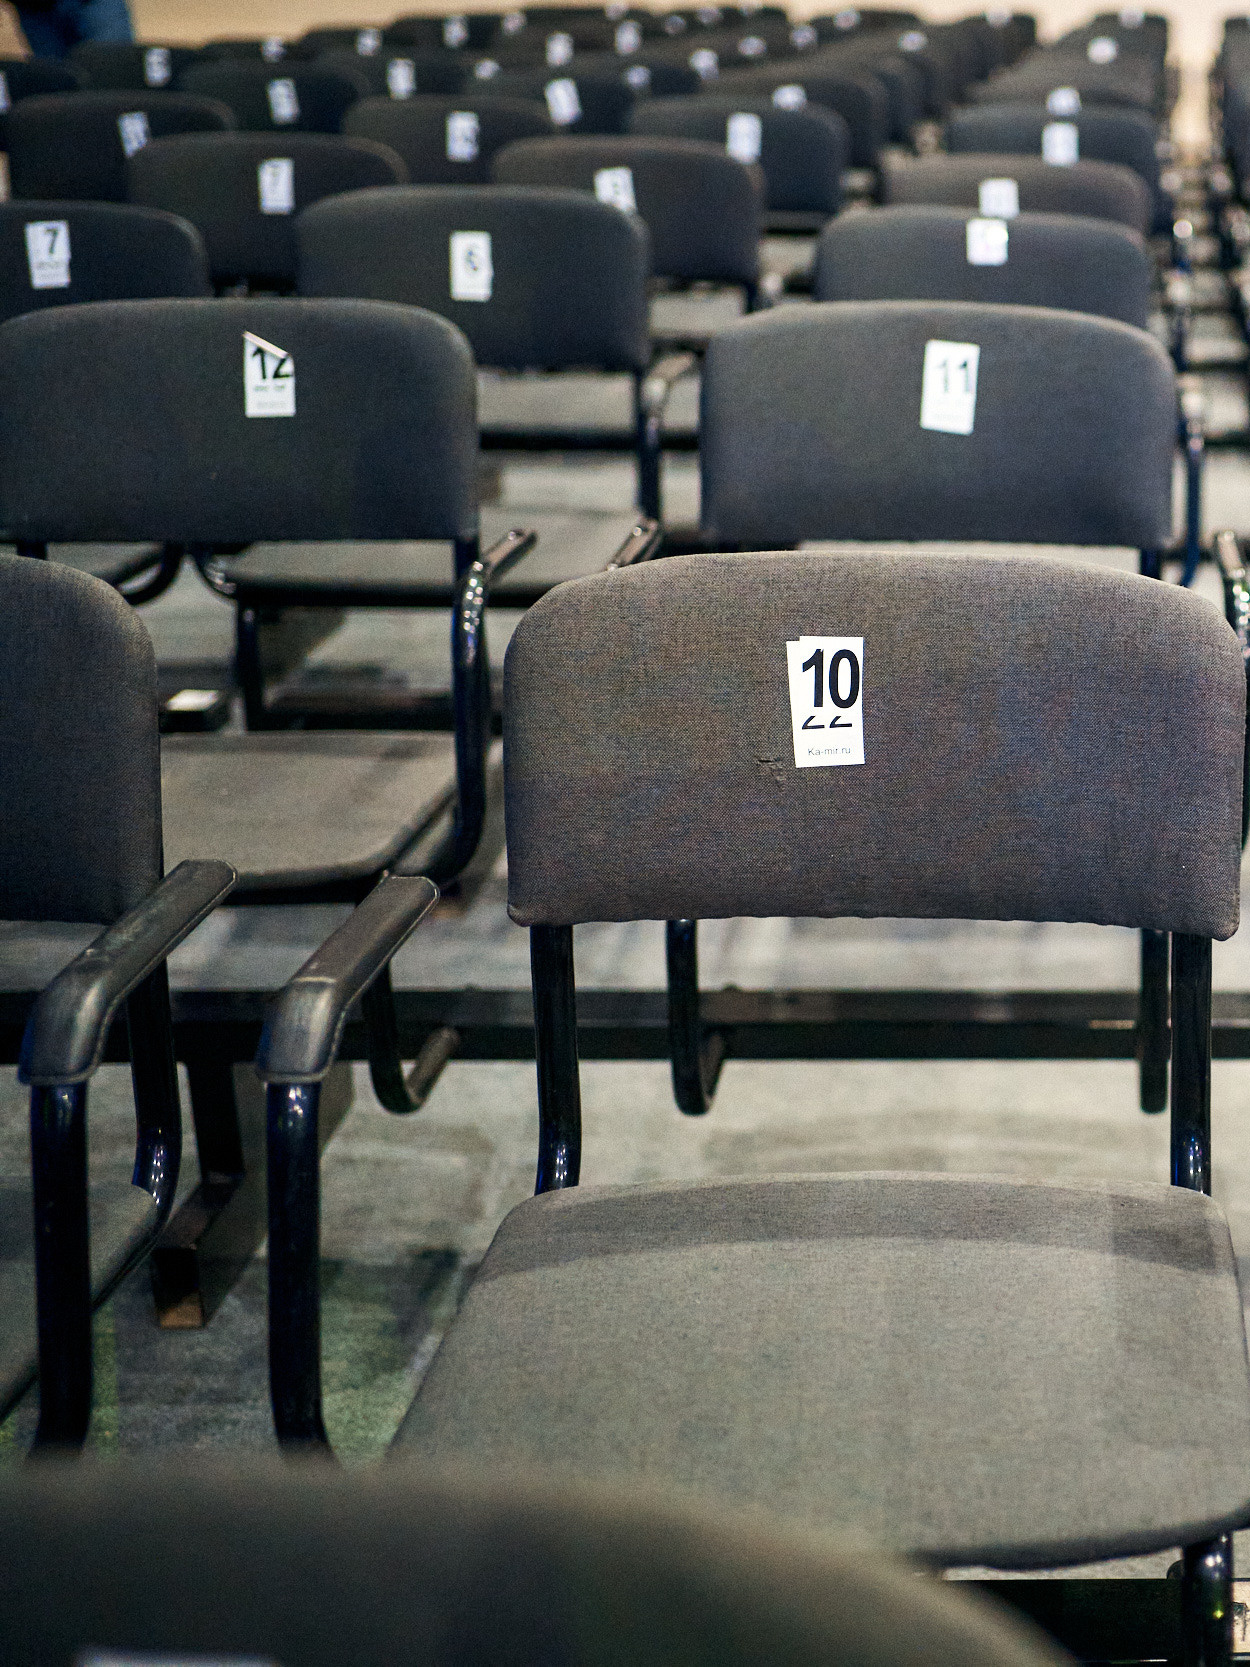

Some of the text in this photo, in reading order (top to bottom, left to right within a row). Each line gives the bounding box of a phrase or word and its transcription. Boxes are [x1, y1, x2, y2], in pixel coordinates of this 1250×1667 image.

[44, 226, 59, 254] 7
[933, 356, 970, 394] 11
[802, 649, 860, 709] 10
